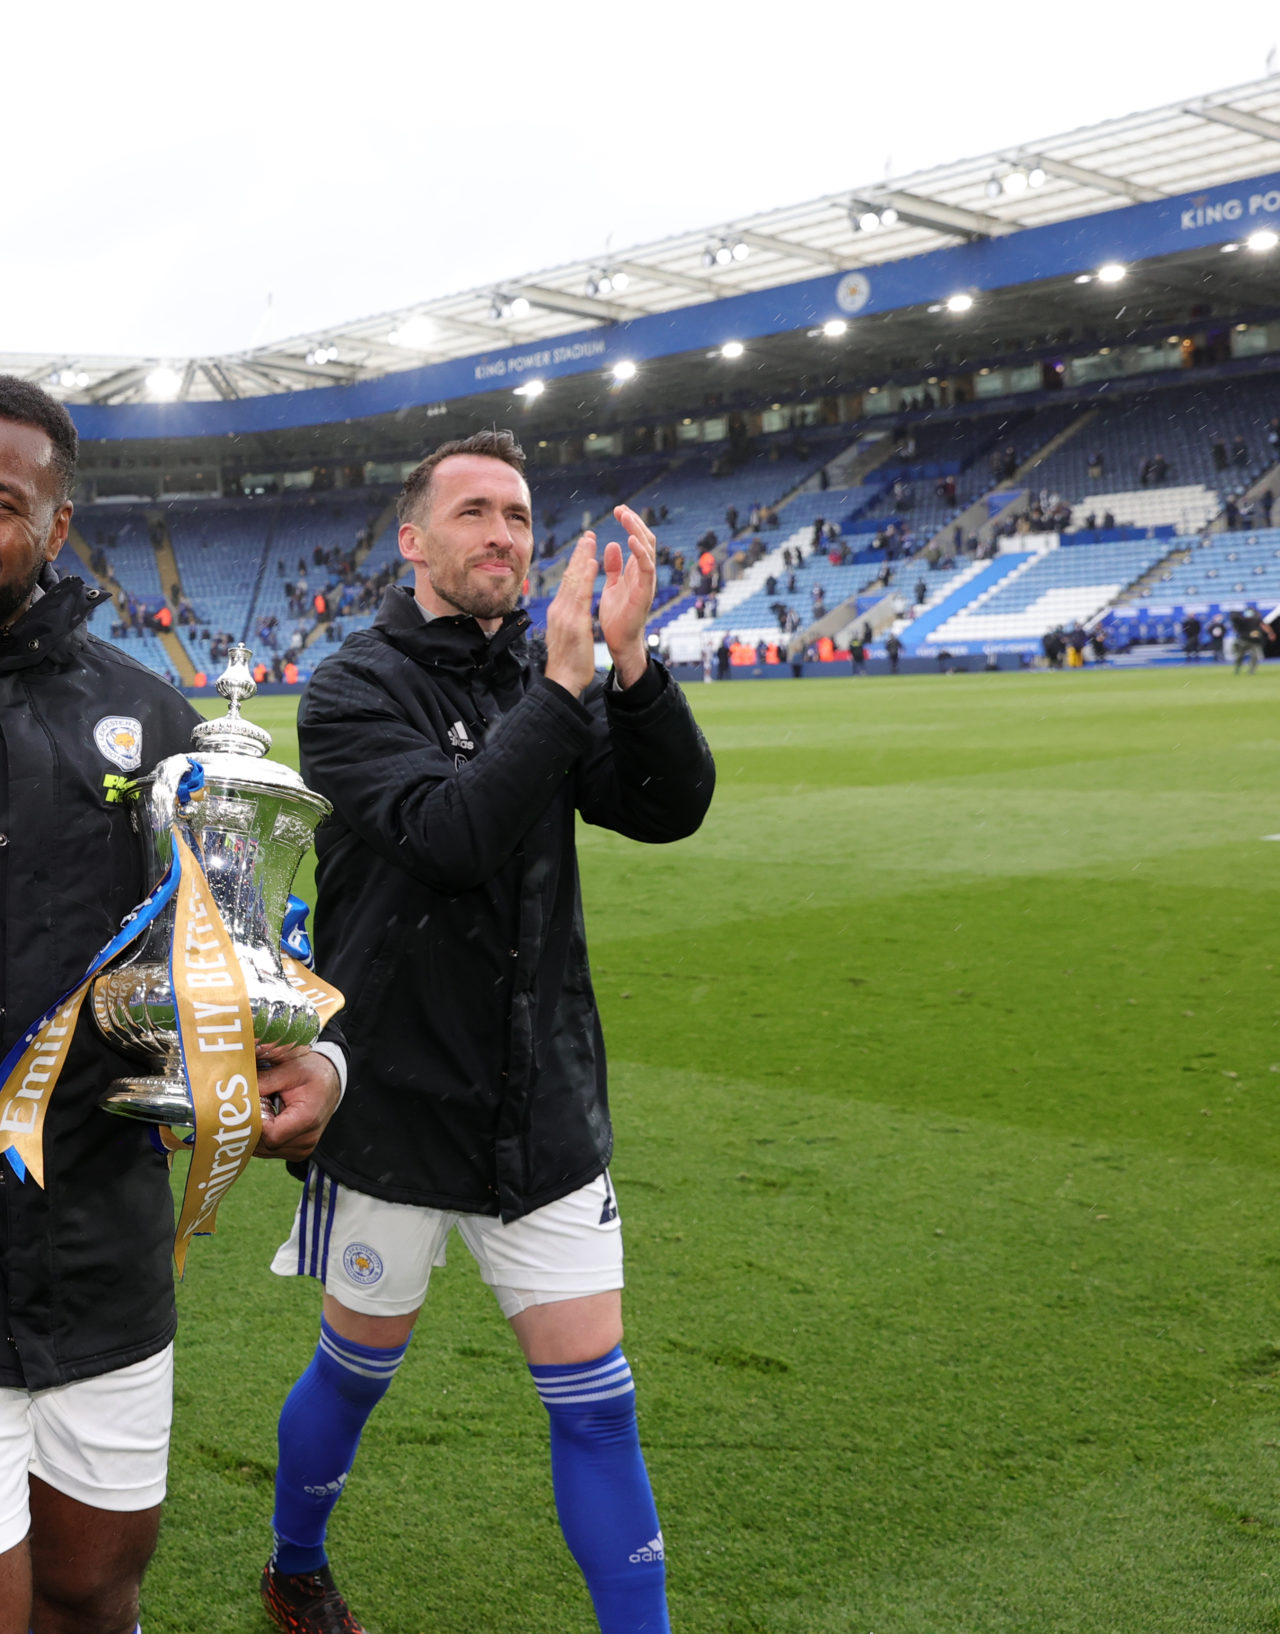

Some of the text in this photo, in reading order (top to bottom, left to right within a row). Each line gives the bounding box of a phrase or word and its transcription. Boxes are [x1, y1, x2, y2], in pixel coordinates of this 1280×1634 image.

[1181, 200, 1243, 230] KING
[475, 340, 606, 380] KING POWER STADIUM
[193, 1001, 244, 1052] FLY
